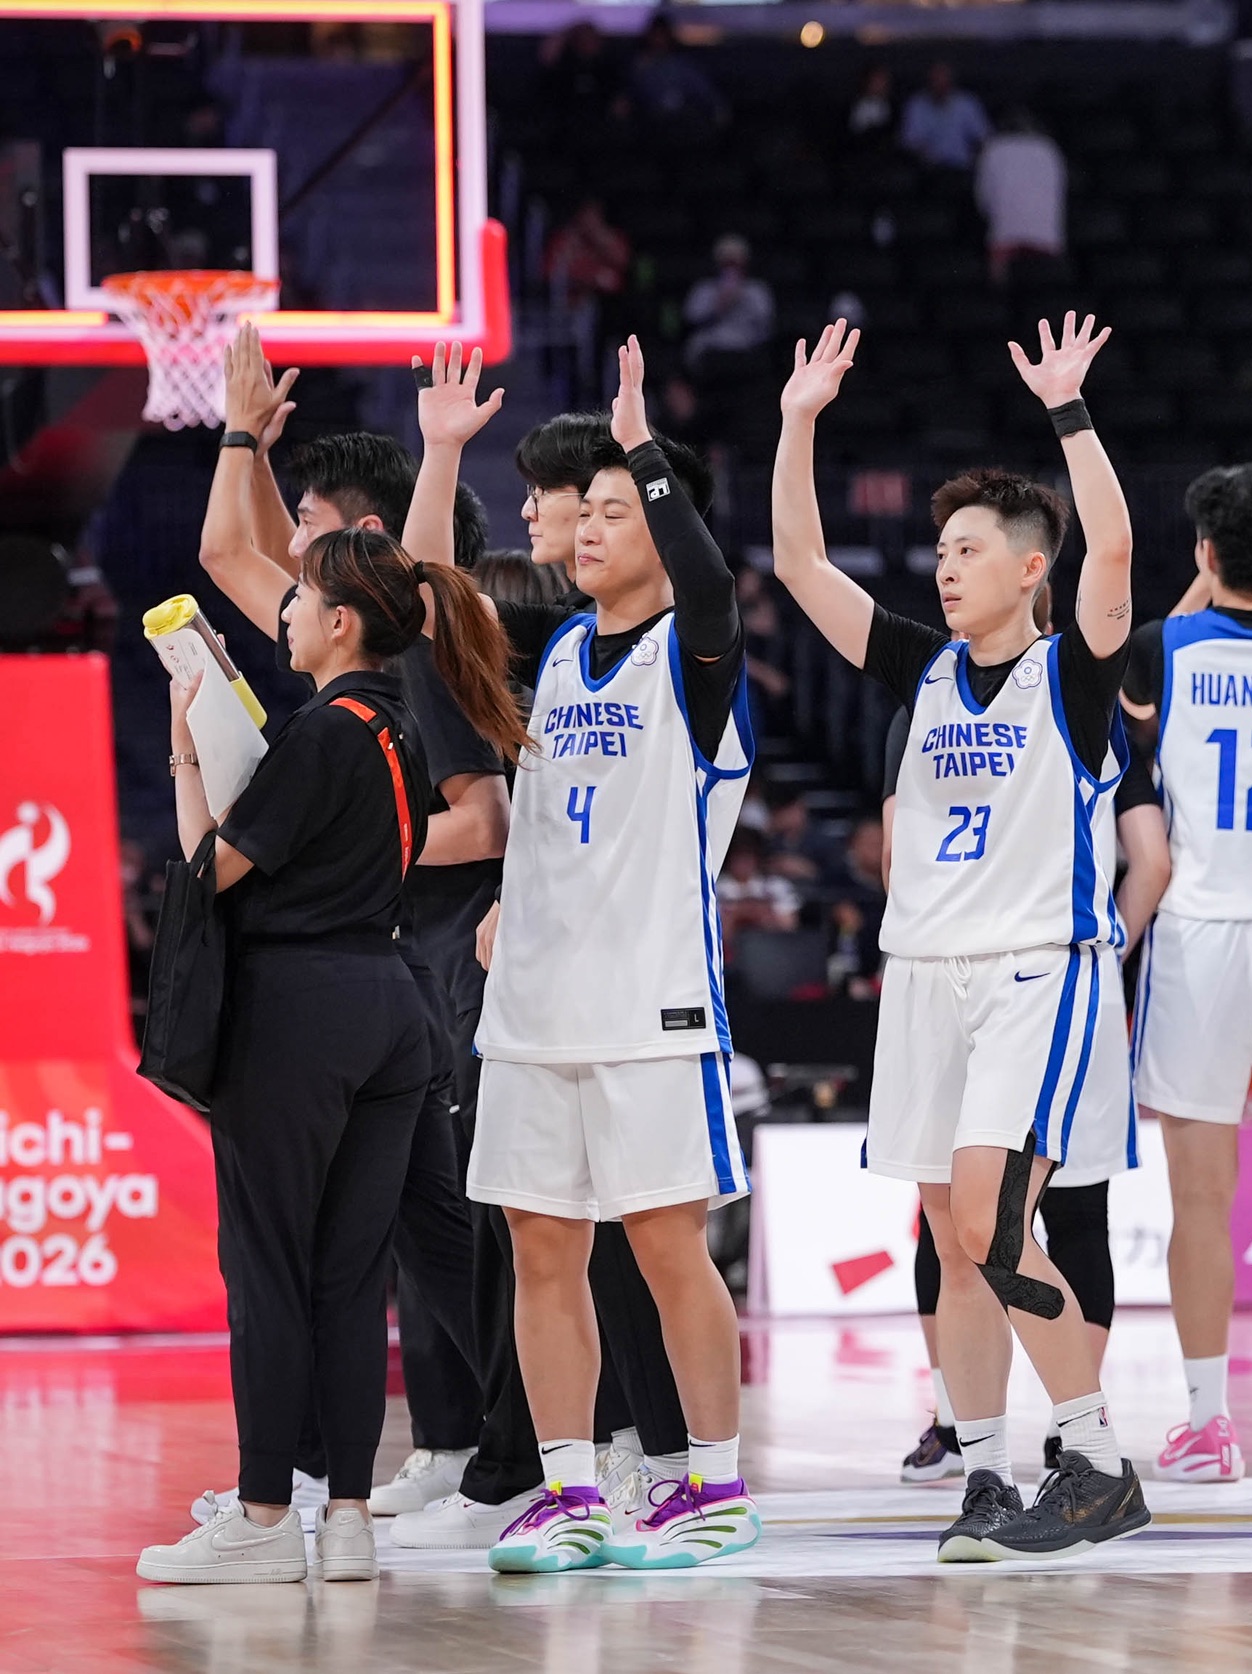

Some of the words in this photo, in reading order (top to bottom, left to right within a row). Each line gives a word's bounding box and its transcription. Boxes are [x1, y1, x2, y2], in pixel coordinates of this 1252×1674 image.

[551, 731, 628, 759] TAIPEI
[921, 723, 1028, 753] CHINESE
[933, 752, 1015, 779] TAIPEI
[567, 786, 597, 844] 4
[935, 805, 991, 861] 23
[0, 1173, 158, 1234] goya
[0, 1231, 118, 1288] 026
